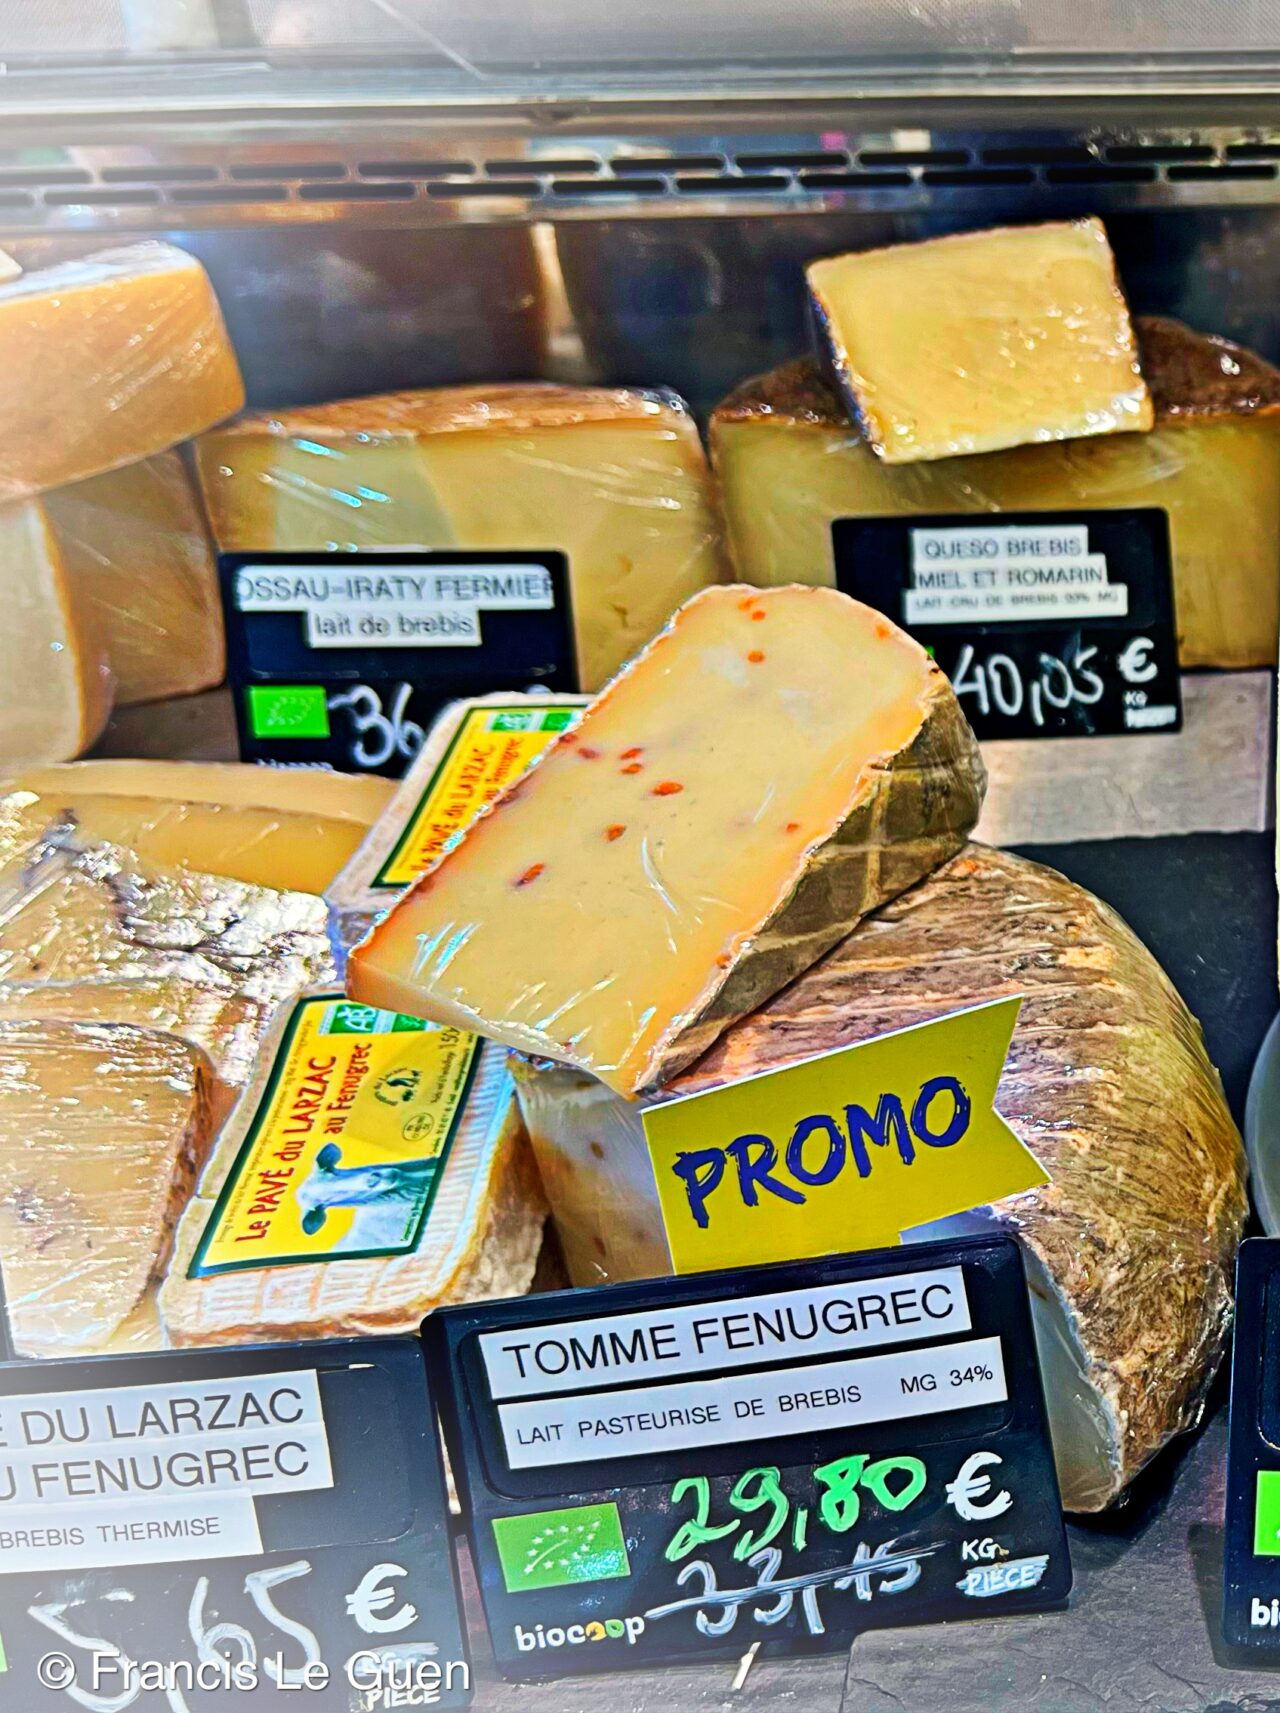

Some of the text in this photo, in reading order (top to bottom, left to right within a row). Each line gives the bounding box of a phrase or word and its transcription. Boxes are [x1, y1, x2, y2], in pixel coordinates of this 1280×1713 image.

[924, 536, 1082, 559] QUESO BREBIS
[239, 575, 426, 601] OSSAU-IRATY
[918, 567, 1103, 589] MIEL ET ROMARIN
[314, 610, 474, 637] lait de brebis
[951, 636, 1158, 726] 40,05 €
[282, 1055, 337, 1135] LARZAC
[326, 1042, 373, 1111] Fenugrec
[323, 1115, 349, 1135] au
[272, 1139, 306, 1162] du
[671, 1075, 972, 1229] PROMO
[246, 1166, 295, 1216] PAVÉ
[234, 1220, 271, 1243] Le
[502, 1284, 955, 1380] TOMME FENUGREC
[20, 1406, 90, 1446] DU
[106, 1387, 305, 1440] LARZAC
[516, 1363, 995, 1447] LAIT PASTEURISE DE BREBIS MG 34%
[32, 1440, 310, 1499] FENUGREC
[664, 1451, 1014, 1562] 29,80 €
[0, 1516, 221, 1550] BREBIS THERMISE
[961, 1537, 1001, 1561] KG
[344, 1562, 419, 1634] €
[514, 1613, 647, 1653] biocoop
